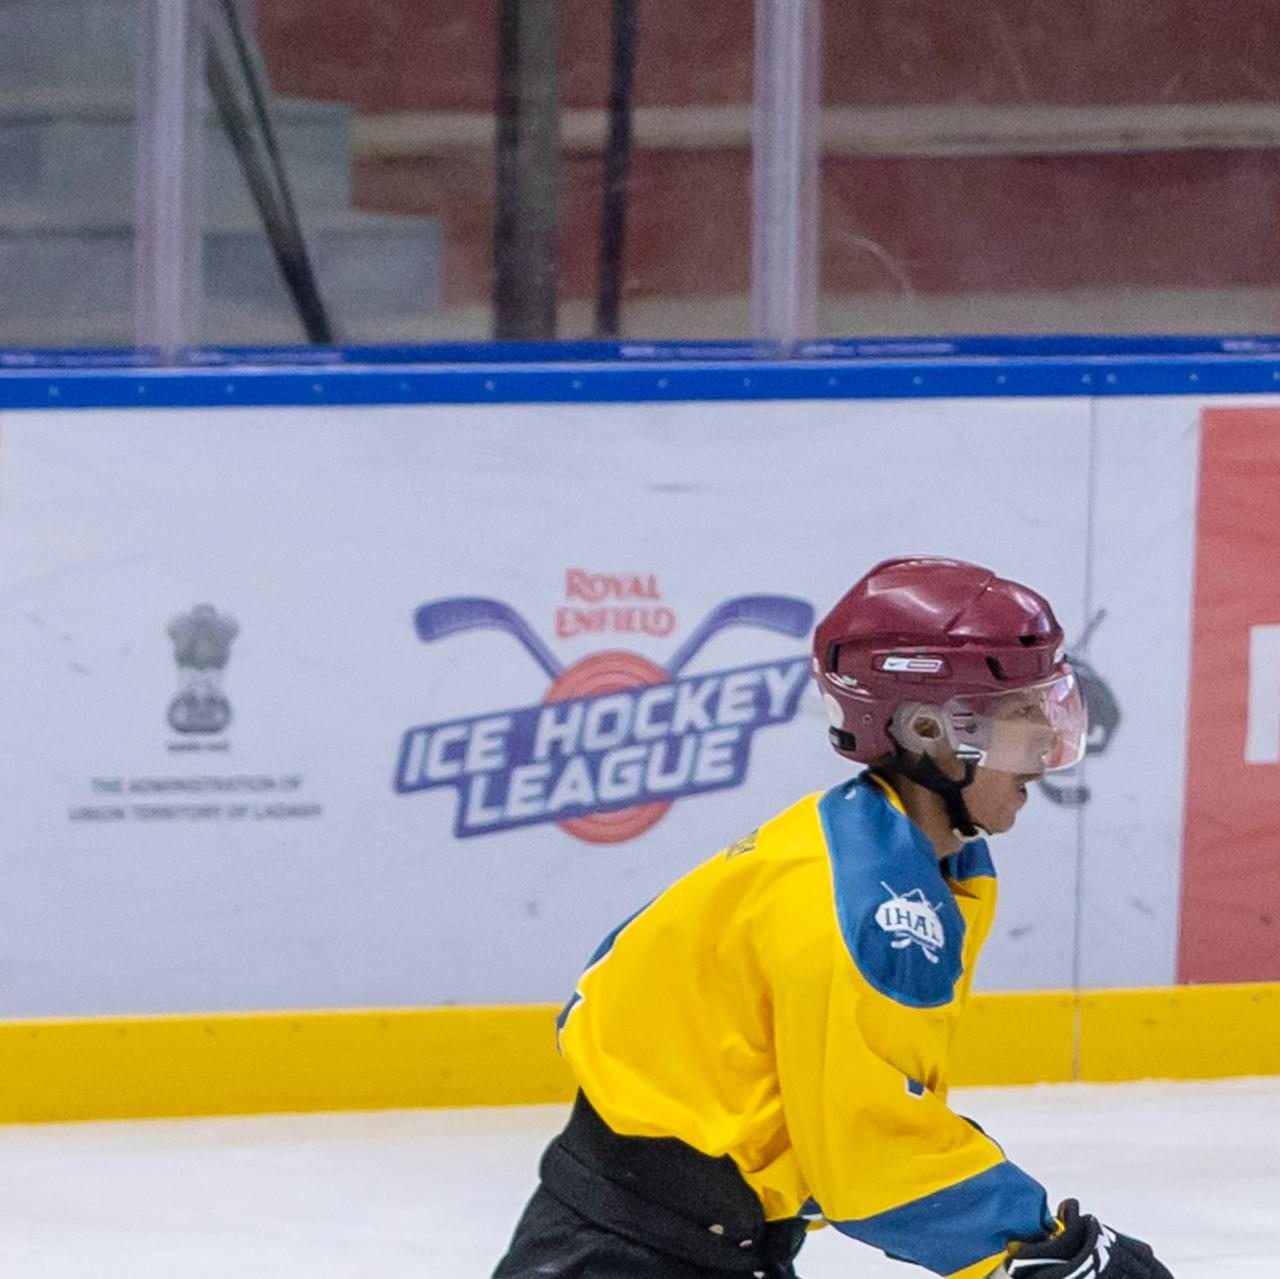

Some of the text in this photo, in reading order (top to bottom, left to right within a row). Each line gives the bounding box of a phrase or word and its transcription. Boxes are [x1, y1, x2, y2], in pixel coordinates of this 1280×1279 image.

[566, 568, 660, 601] ROYAL
[555, 606, 676, 639] ENFIELD
[402, 662, 805, 786] ICE HOCKEY
[463, 726, 741, 827] LEAGUE
